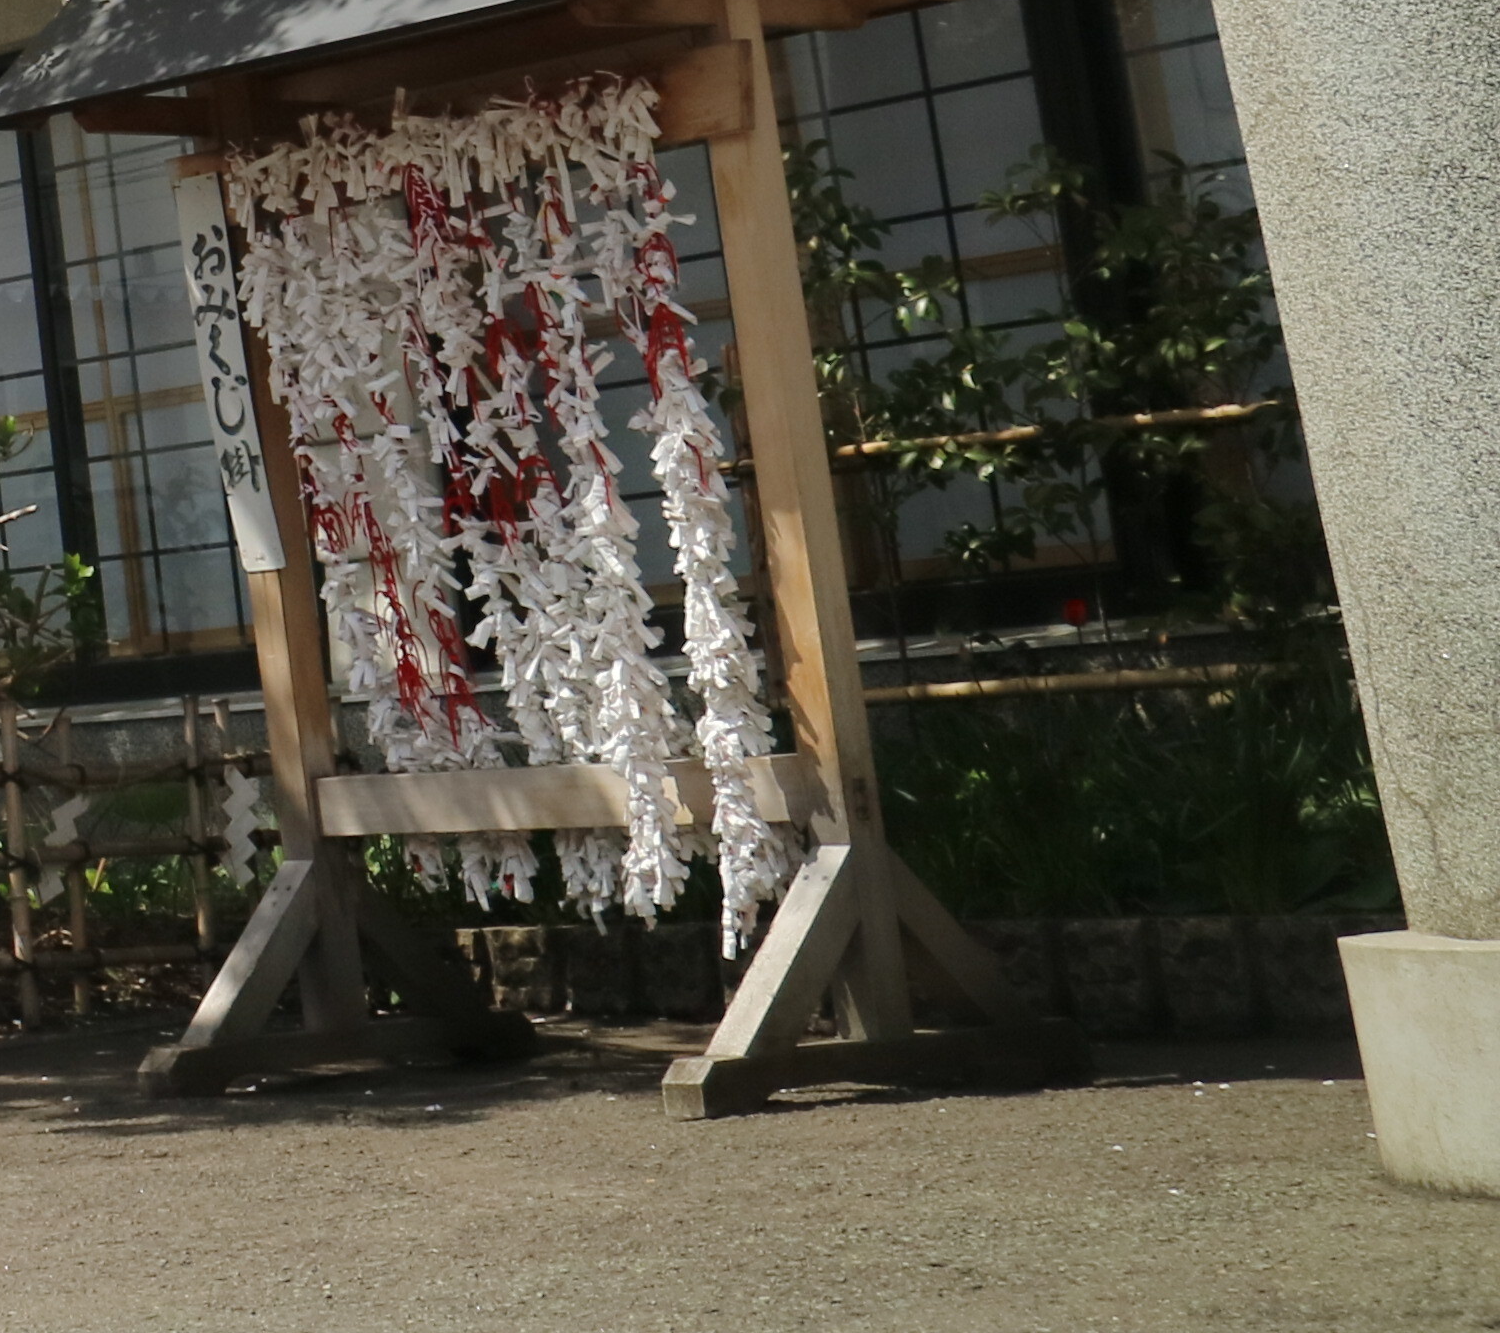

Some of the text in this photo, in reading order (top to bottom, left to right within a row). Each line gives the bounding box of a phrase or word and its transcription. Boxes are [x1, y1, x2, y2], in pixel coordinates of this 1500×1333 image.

[192, 224, 261, 493] おみくじ掛
